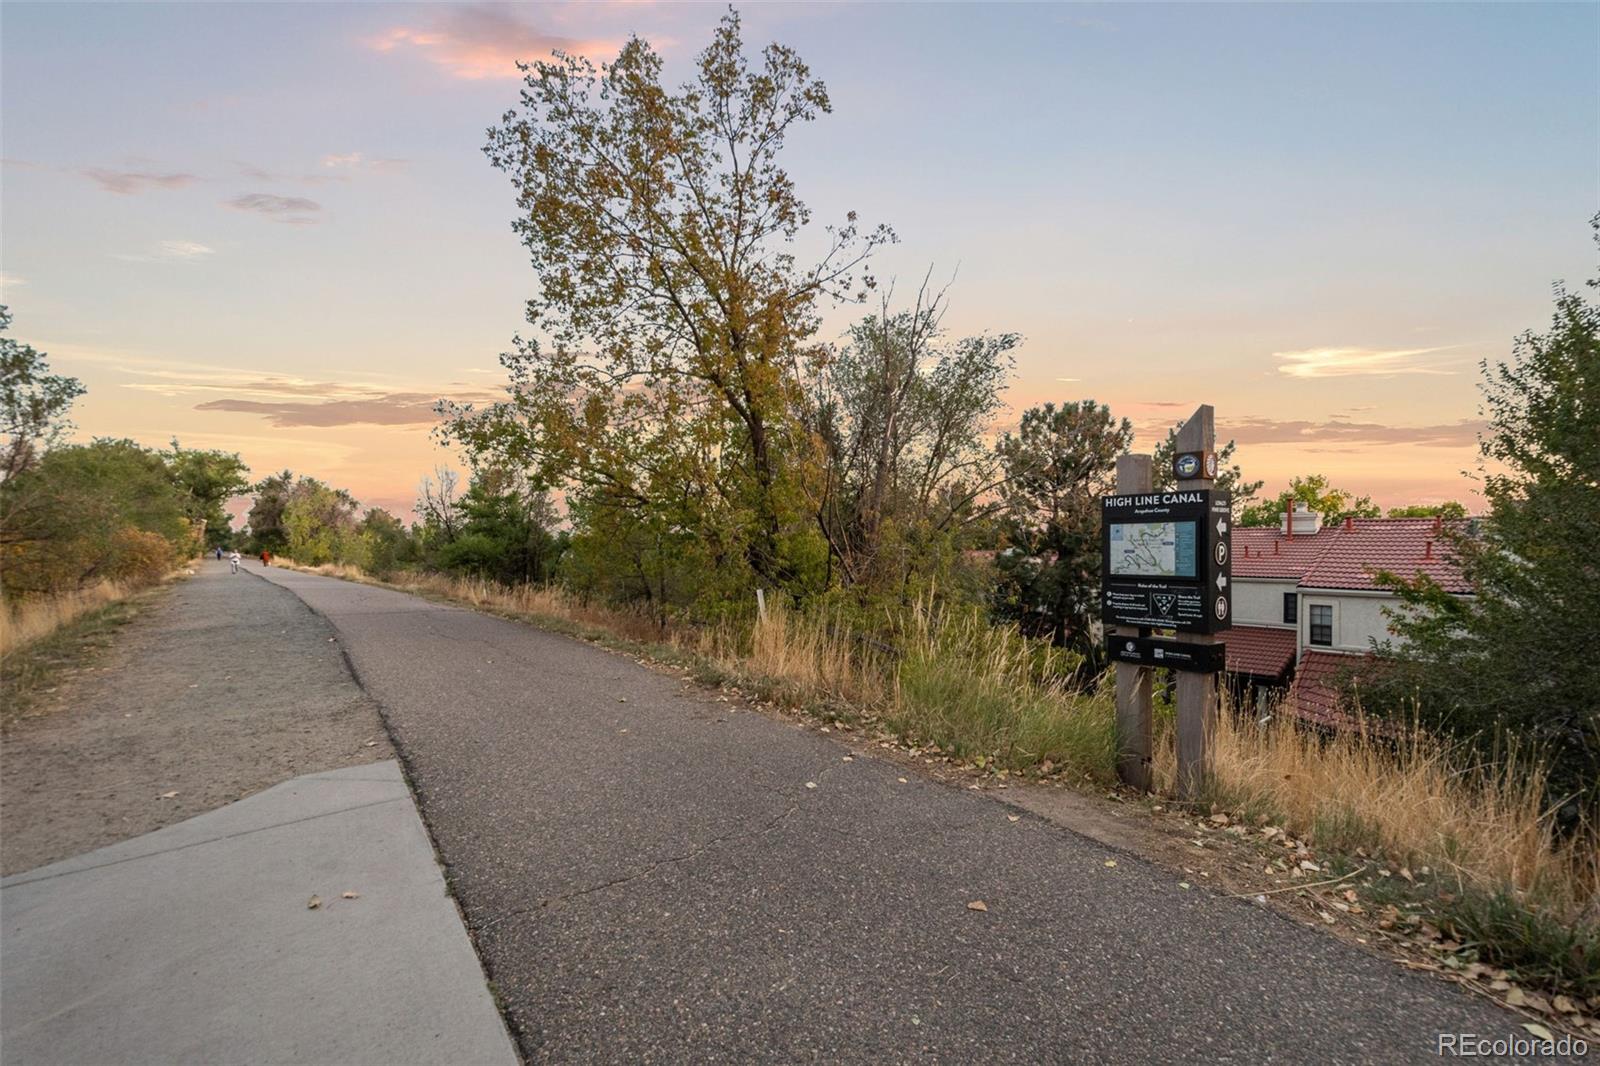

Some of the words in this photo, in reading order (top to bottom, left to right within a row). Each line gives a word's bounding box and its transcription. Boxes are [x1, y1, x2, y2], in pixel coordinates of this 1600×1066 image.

[1105, 497, 1132, 507] HIGH
[1135, 495, 1160, 506] LINE
[1162, 492, 1204, 504] CANAL
